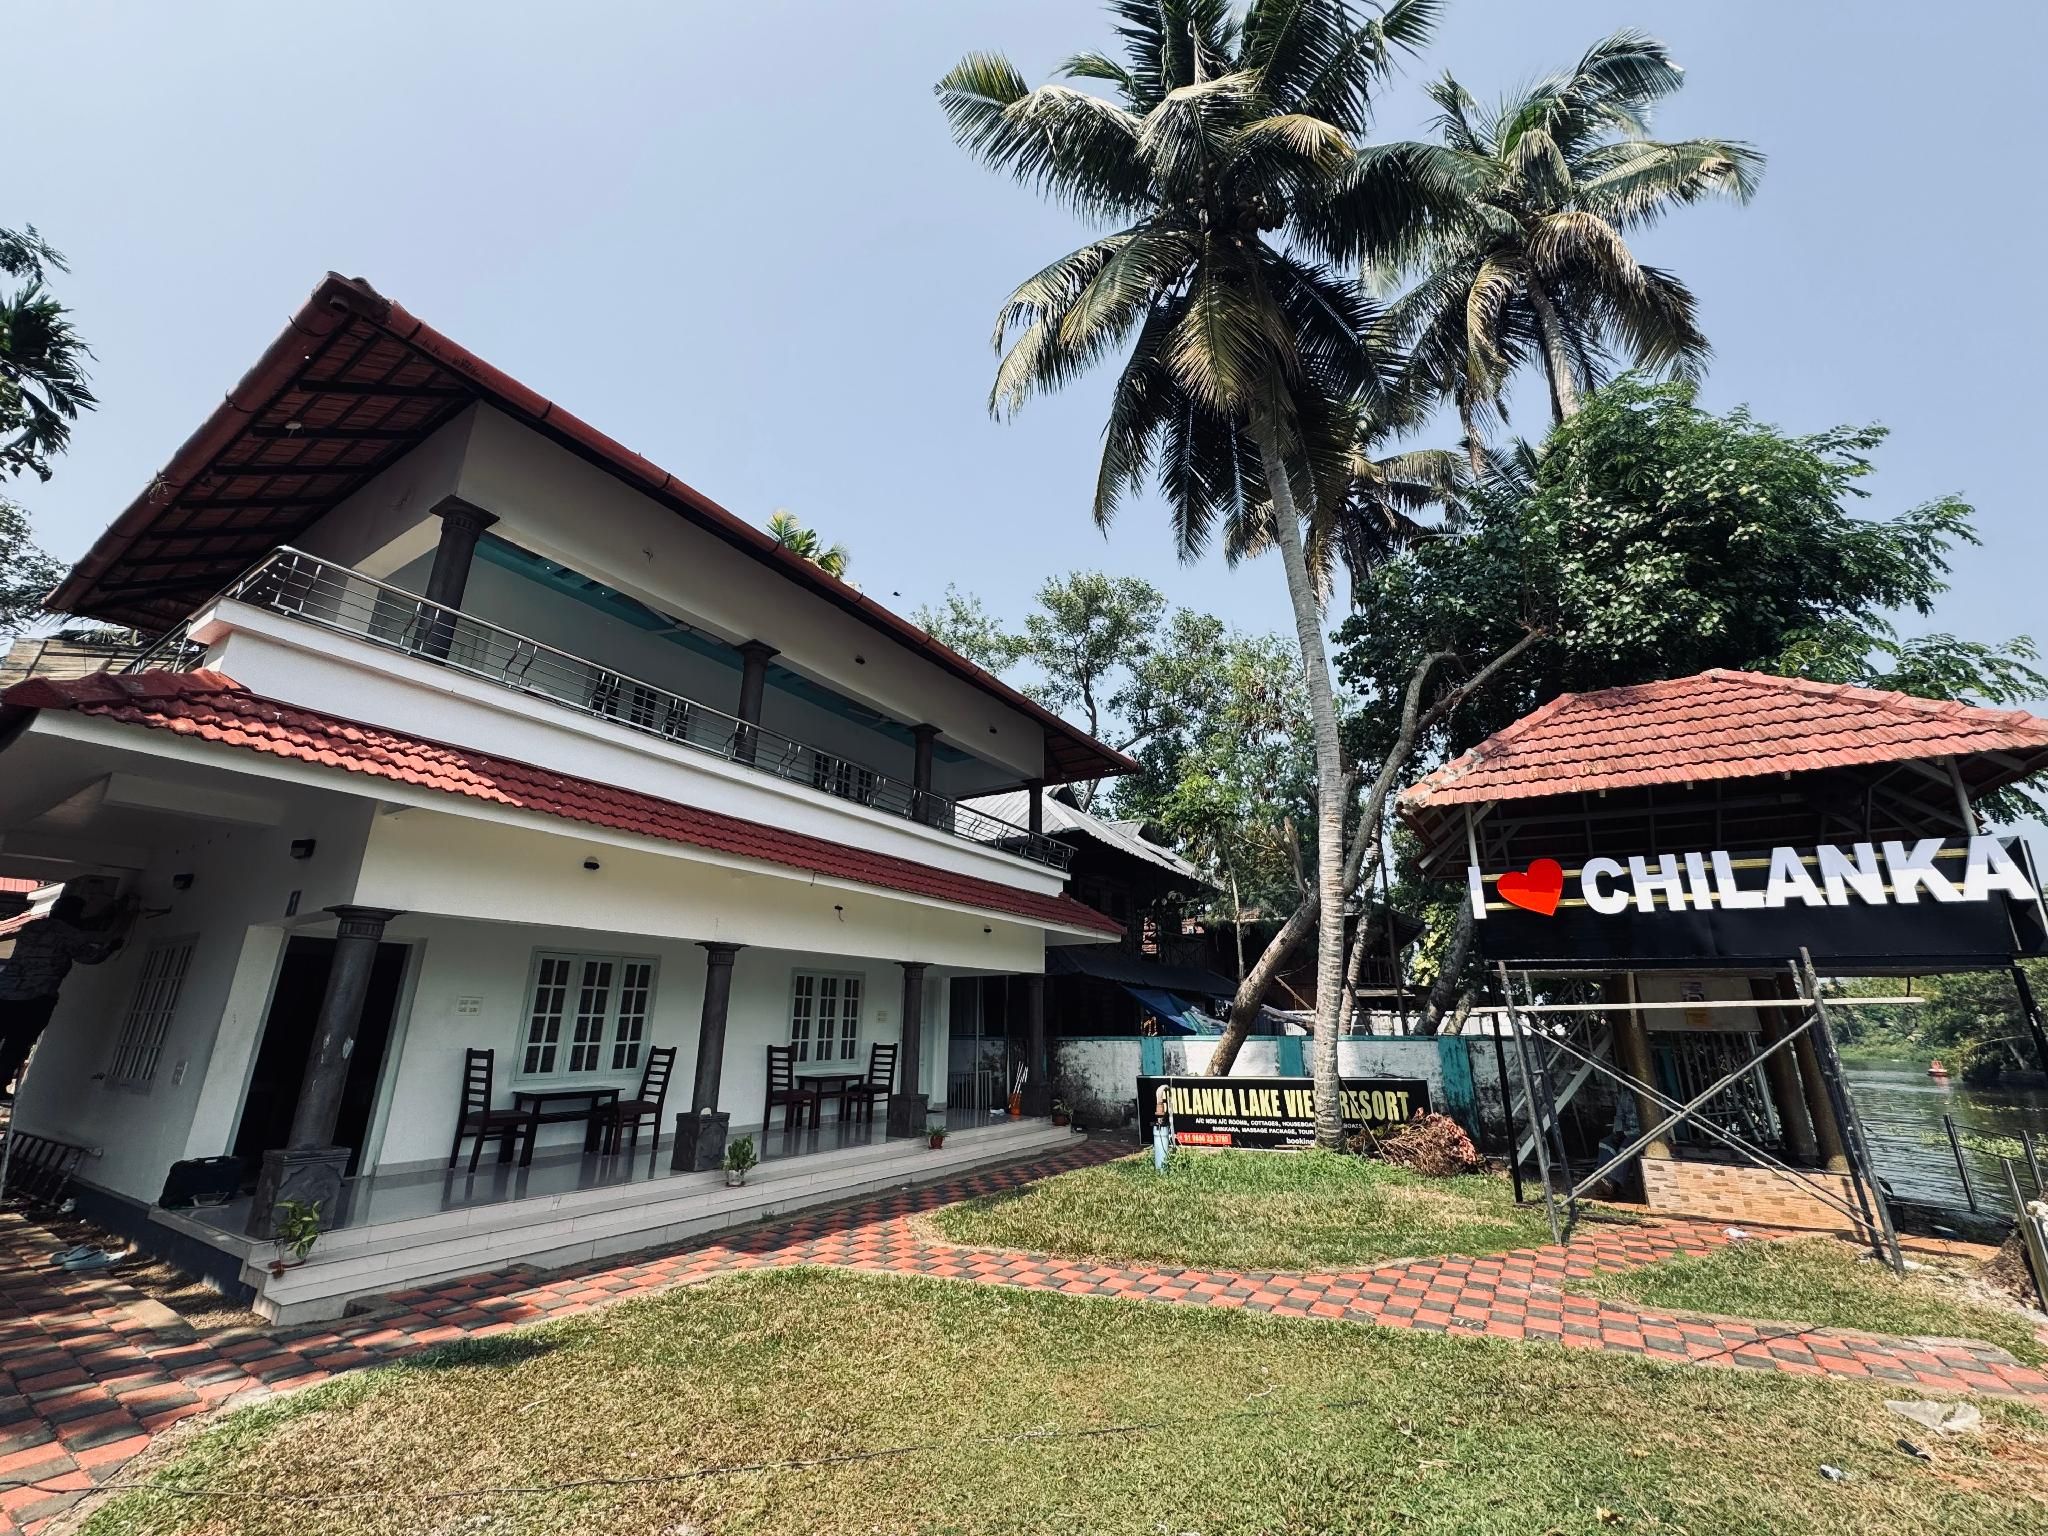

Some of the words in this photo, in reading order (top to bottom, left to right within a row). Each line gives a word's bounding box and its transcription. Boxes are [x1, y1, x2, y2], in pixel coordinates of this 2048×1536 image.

[1467, 866, 1487, 919] I
[1581, 834, 2040, 915] CHILANKA
[1238, 1088, 1282, 1117] LAKE
[1283, 1089, 1316, 1118] VIE
[1338, 1090, 1409, 1121] RESORT
